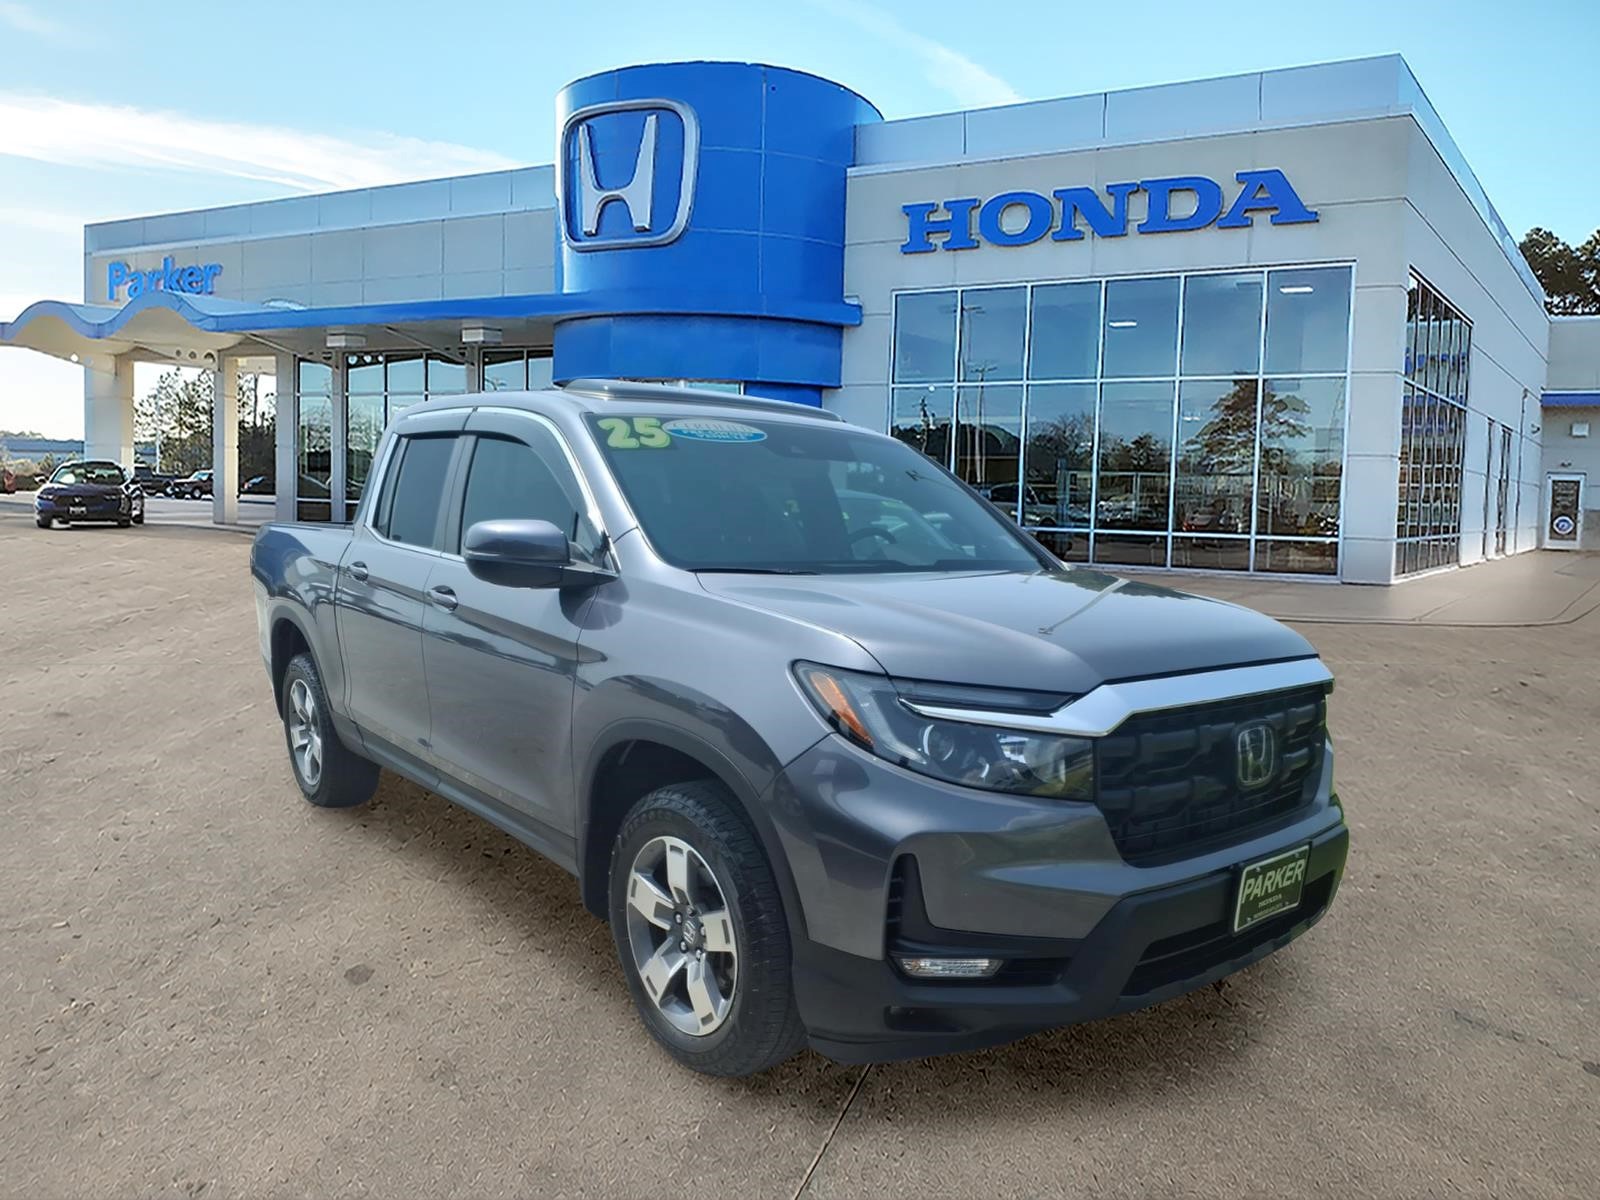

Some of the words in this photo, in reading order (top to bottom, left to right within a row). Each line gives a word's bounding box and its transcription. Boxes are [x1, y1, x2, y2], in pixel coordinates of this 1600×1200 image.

[901, 169, 1319, 255] HONDA
[107, 255, 223, 301] Parker
[597, 417, 671, 449] 25
[1241, 859, 1305, 904] PARKER
